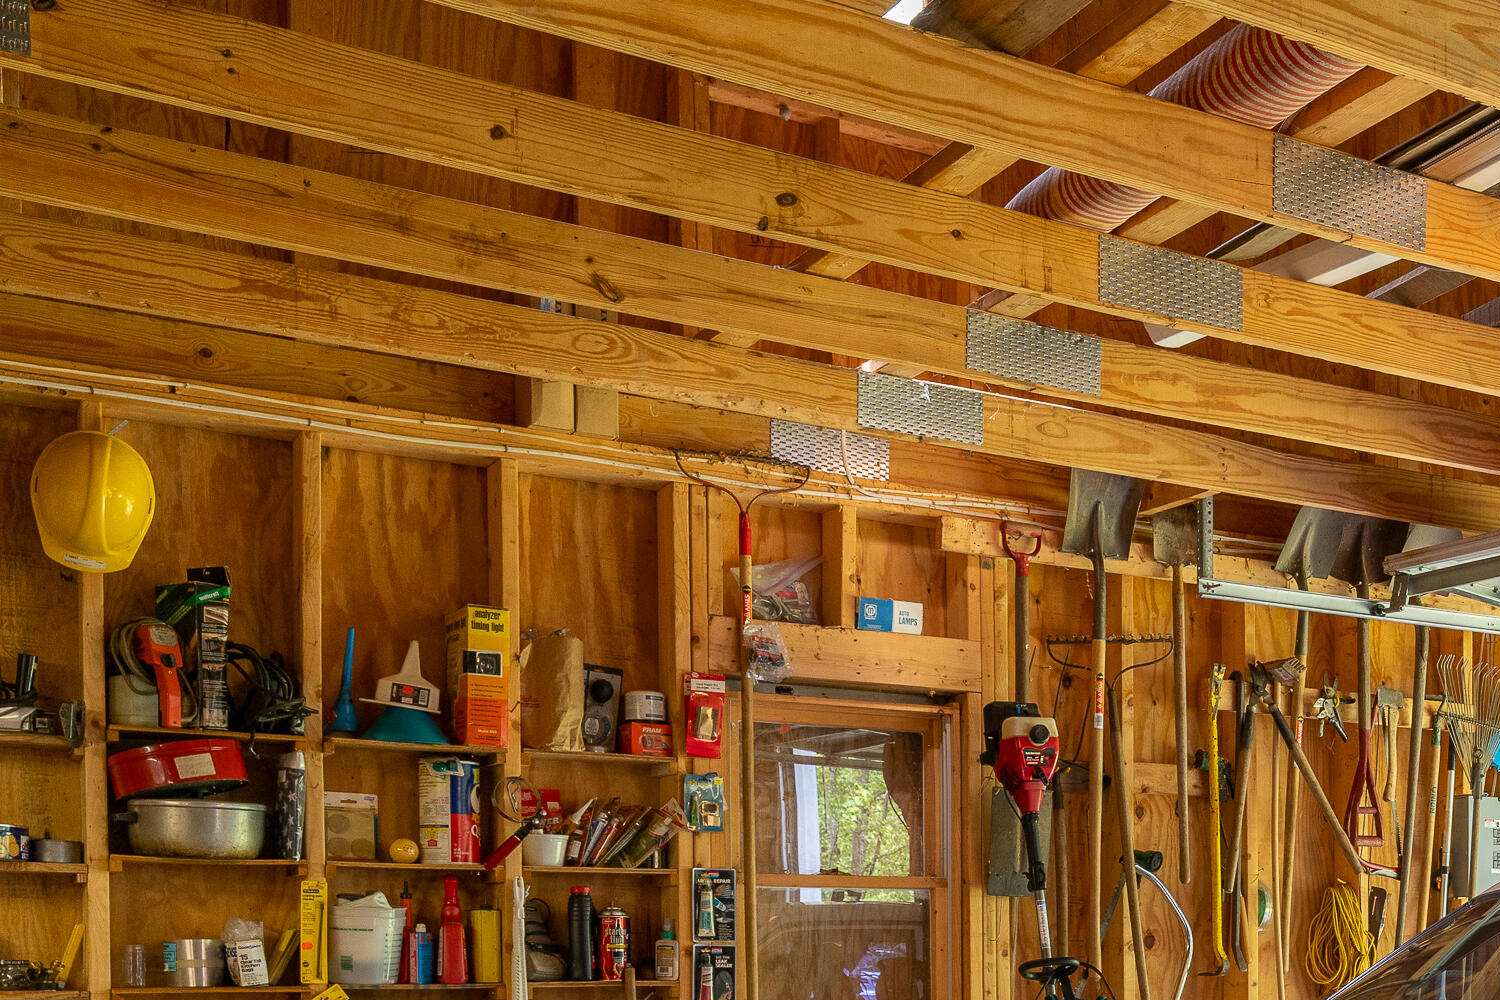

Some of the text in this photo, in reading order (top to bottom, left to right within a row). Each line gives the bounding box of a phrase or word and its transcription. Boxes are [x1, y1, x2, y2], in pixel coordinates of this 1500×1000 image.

[474, 609, 501, 621] analyzer
[471, 620, 490, 633] timing
[491, 622, 505, 633] light
[898, 616, 919, 627] LAMPS
[642, 726, 662, 734] FRAM
